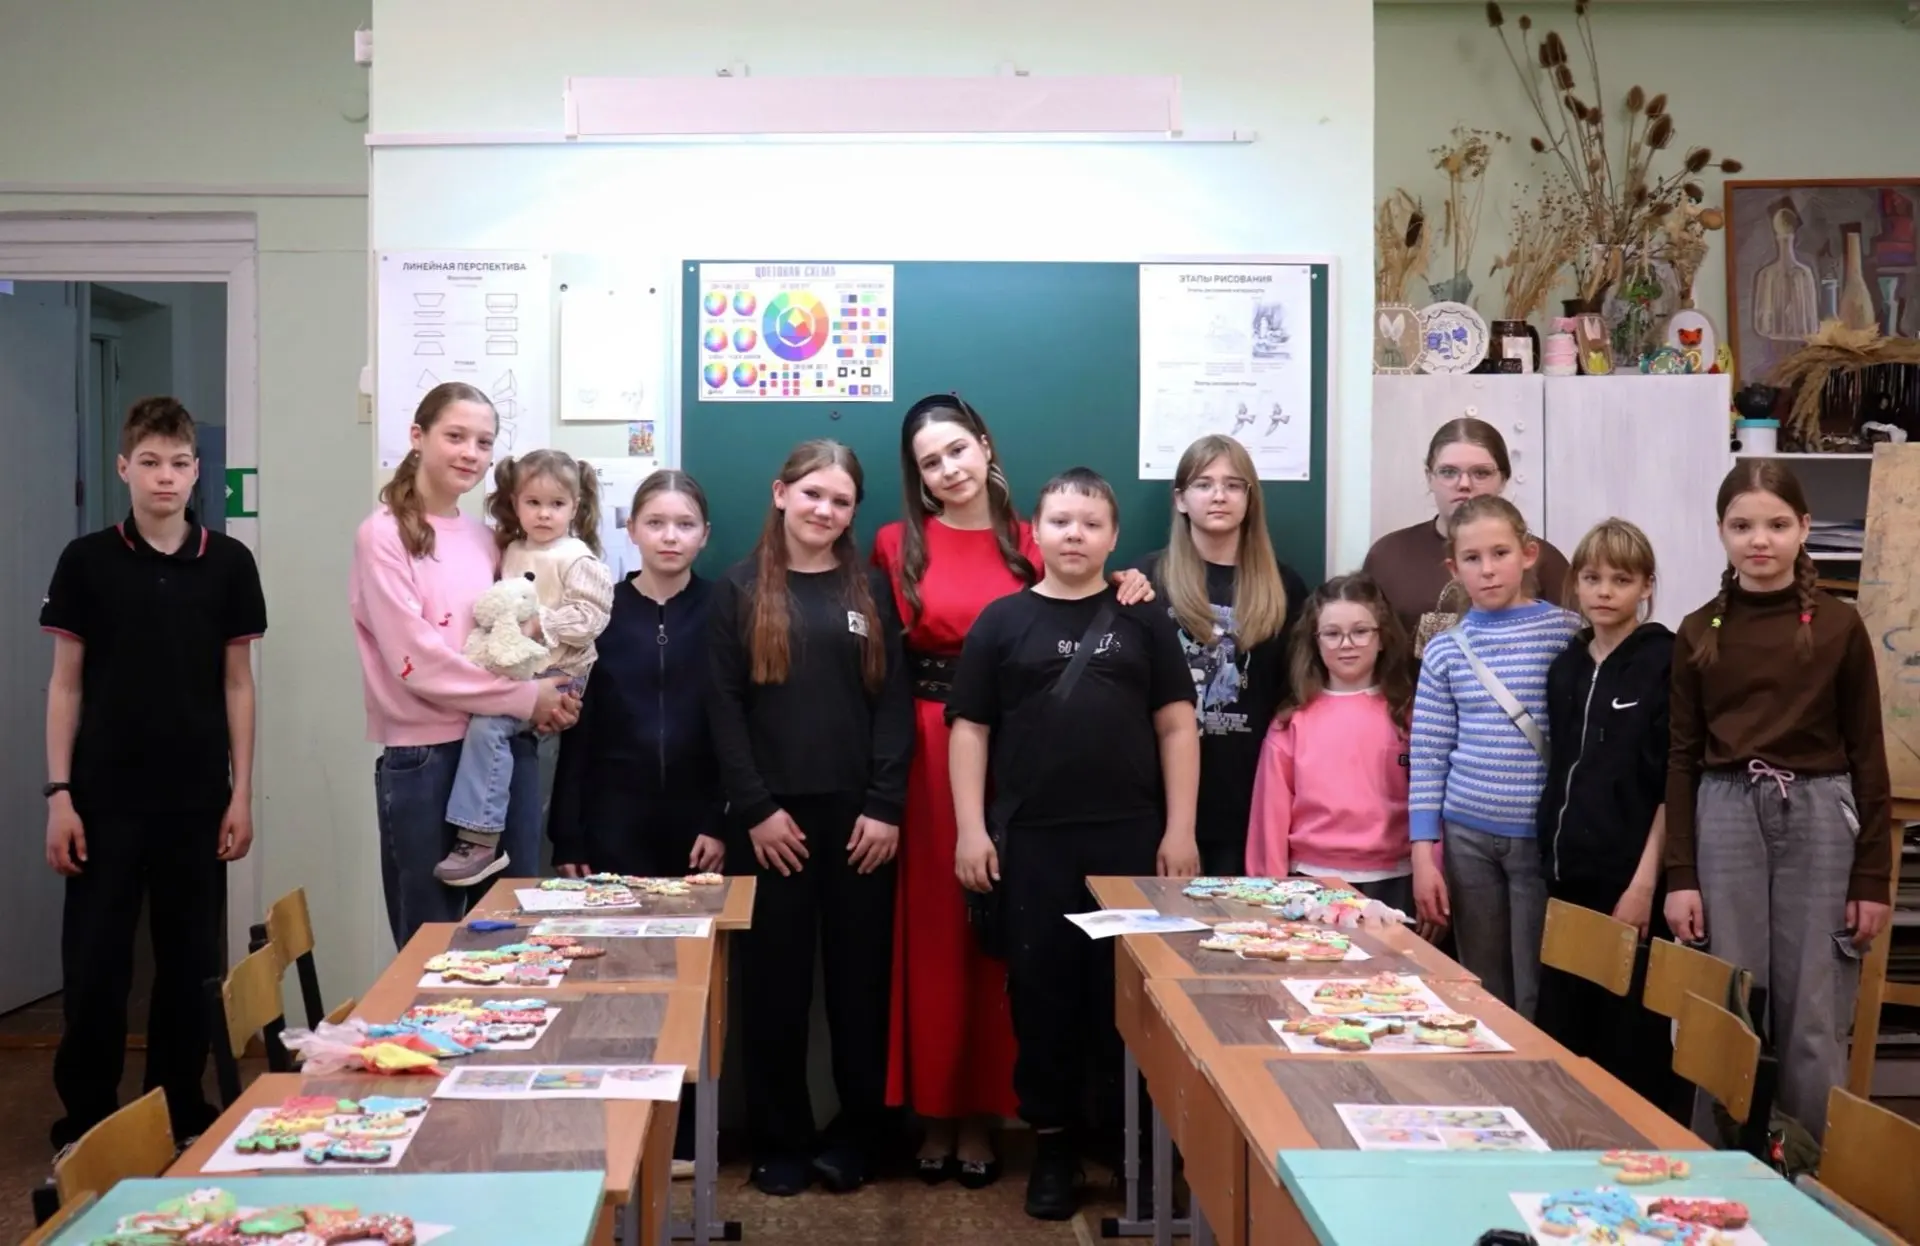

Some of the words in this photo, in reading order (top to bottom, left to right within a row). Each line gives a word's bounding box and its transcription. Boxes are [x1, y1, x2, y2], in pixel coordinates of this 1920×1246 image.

[402, 261, 455, 271] ЛИНЕЙНАЯ
[457, 262, 527, 271] ПЕРСПЕКТИВА
[1179, 275, 1212, 283] ЭТАПЫ
[1214, 275, 1273, 283] РИСОВАНИЯ
[1057, 640, 1073, 654] SO
